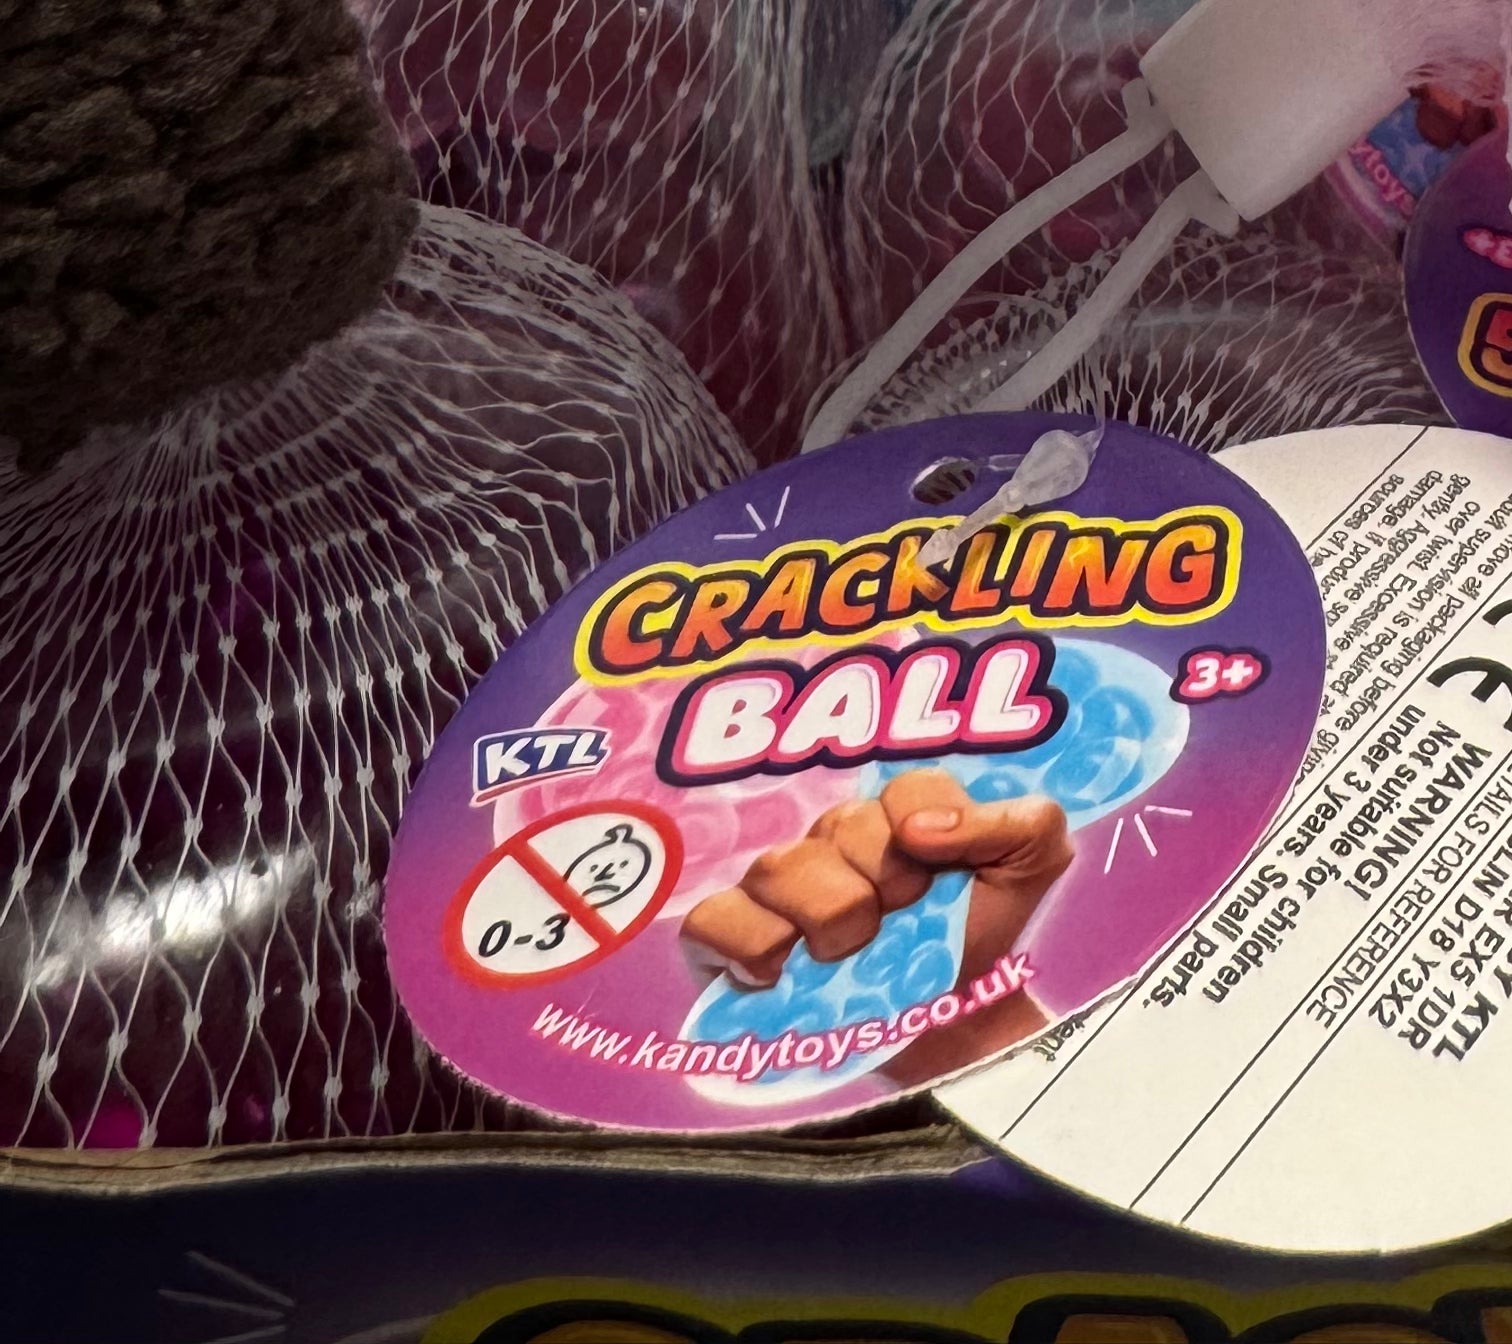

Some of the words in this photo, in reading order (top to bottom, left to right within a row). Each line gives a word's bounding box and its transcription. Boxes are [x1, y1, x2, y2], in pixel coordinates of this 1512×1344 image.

[1443, 500, 1481, 536] over
[600, 514, 1219, 675] CRACKLING
[1342, 518, 1431, 615] Aggressive
[1406, 527, 1492, 611] supervision
[1456, 575, 1482, 601] all
[1332, 572, 1418, 652] Excessive
[1379, 591, 1465, 678] packaging
[1391, 609, 1419, 628] is
[1189, 656, 1253, 694] 3+
[1328, 625, 1398, 697] required
[688, 648, 1043, 761] BALL
[1333, 675, 1397, 731] before
[1360, 703, 1426, 774] under
[480, 729, 608, 786] KTL
[1408, 719, 1461, 768] Not
[1328, 763, 1417, 857] suitable
[1342, 770, 1372, 793] 3
[1275, 783, 1351, 857] years.
[1343, 741, 1492, 901] WARNING!
[1296, 855, 1342, 900] for
[1421, 830, 1476, 884] FOR
[477, 910, 568, 959] 0-3
[1211, 863, 1289, 942] Small
[1428, 892, 1484, 952] D18
[1142, 923, 1219, 1009] parts.
[1201, 896, 1301, 1004] children
[1305, 877, 1435, 1029] REFERENCE
[1449, 921, 1506, 987] EX5
[529, 951, 1039, 1079] www.kandytoys.co.uk
[1367, 952, 1441, 1028] Y3X2
[1397, 985, 1456, 1050] 1DR
[1431, 990, 1498, 1061] KTL
